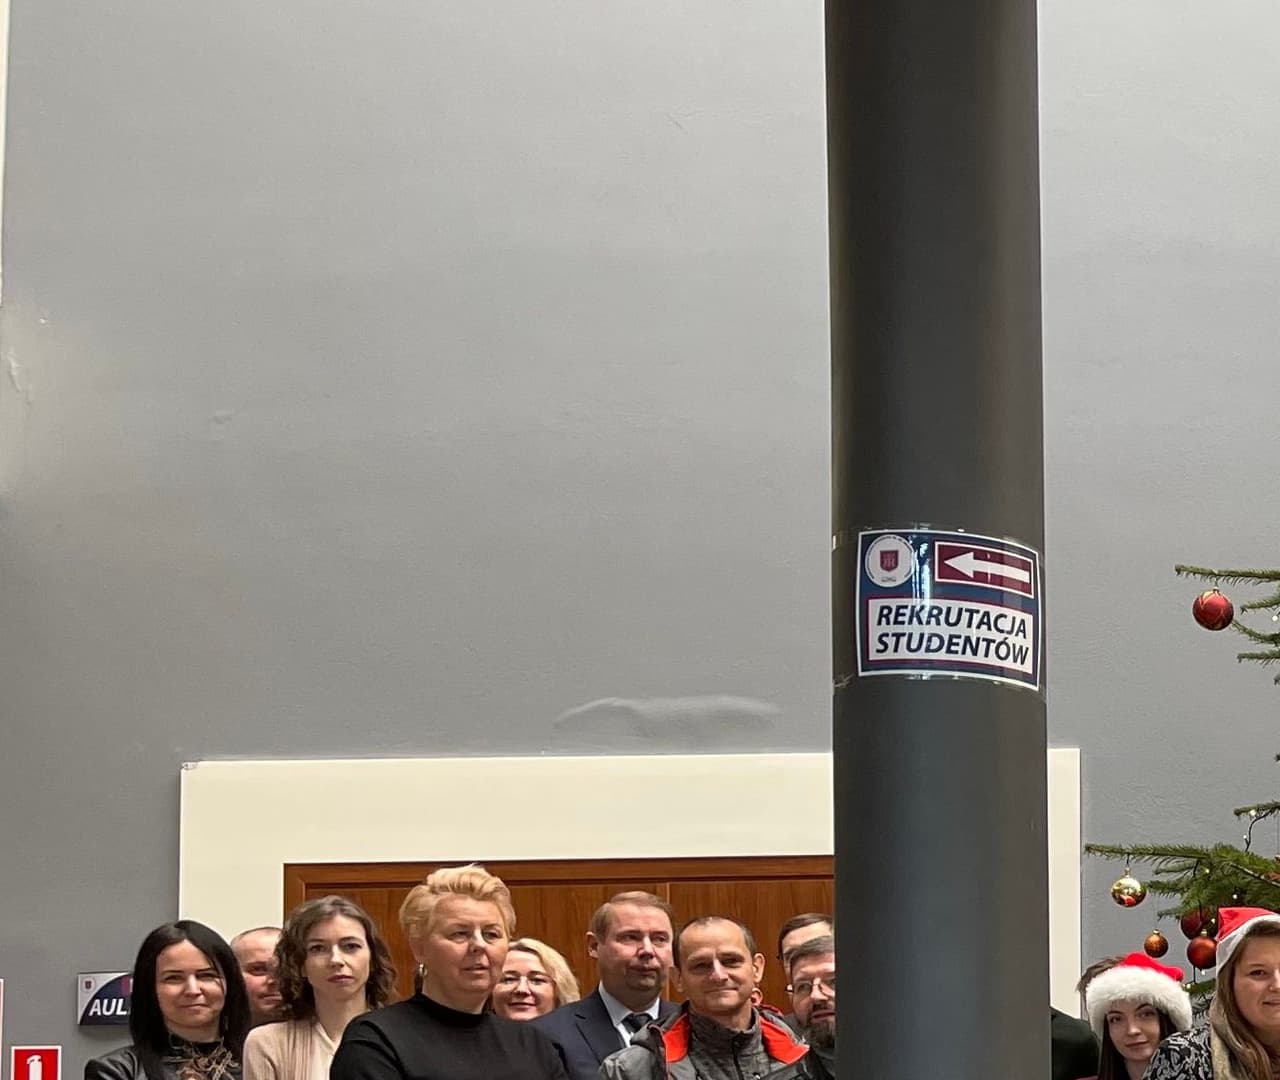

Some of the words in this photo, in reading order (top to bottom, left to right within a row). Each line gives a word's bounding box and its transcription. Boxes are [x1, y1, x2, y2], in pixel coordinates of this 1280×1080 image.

[876, 604, 1028, 640] REKRUTACJA
[875, 631, 1030, 666] STUDENTÓW
[89, 998, 131, 1016] AUL
